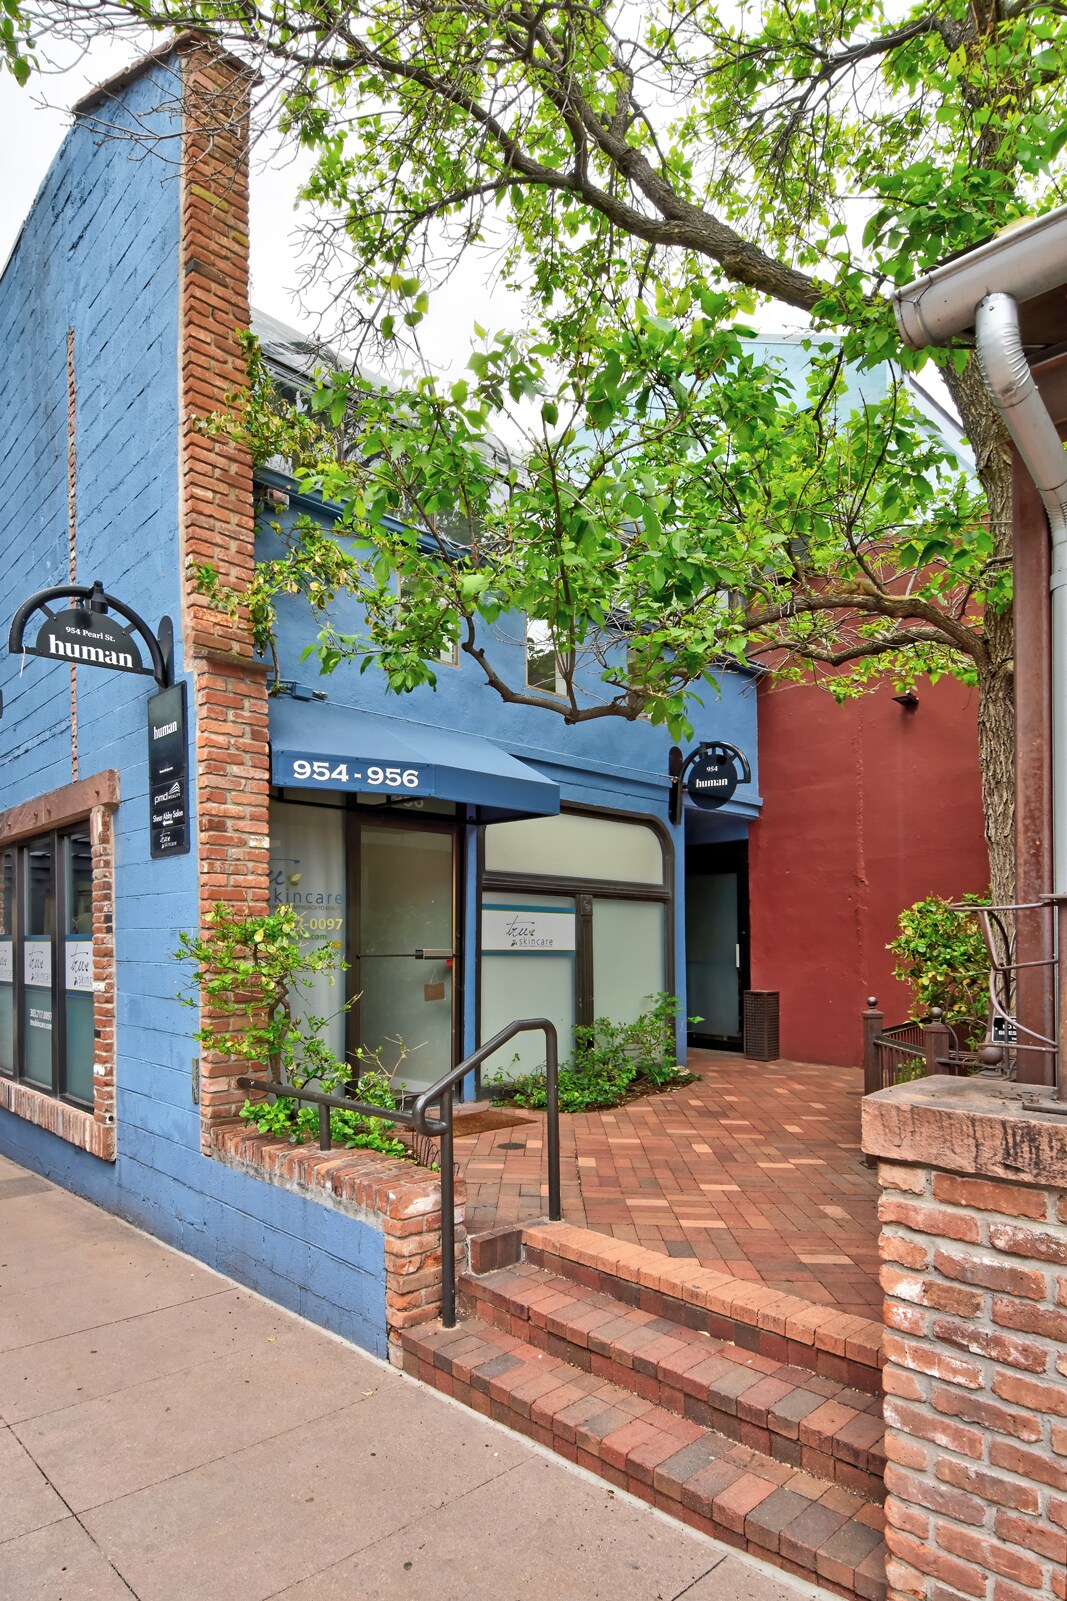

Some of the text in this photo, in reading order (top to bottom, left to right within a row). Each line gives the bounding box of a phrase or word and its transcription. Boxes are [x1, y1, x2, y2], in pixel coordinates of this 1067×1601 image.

[65, 626, 116, 642] 954 Pearl St.
[48, 634, 133, 668] human
[154, 721, 177, 740] human
[706, 765, 718, 773] 954
[695, 778, 728, 788] human
[274, 888, 343, 905] kincare
[519, 937, 554, 947] skincare
